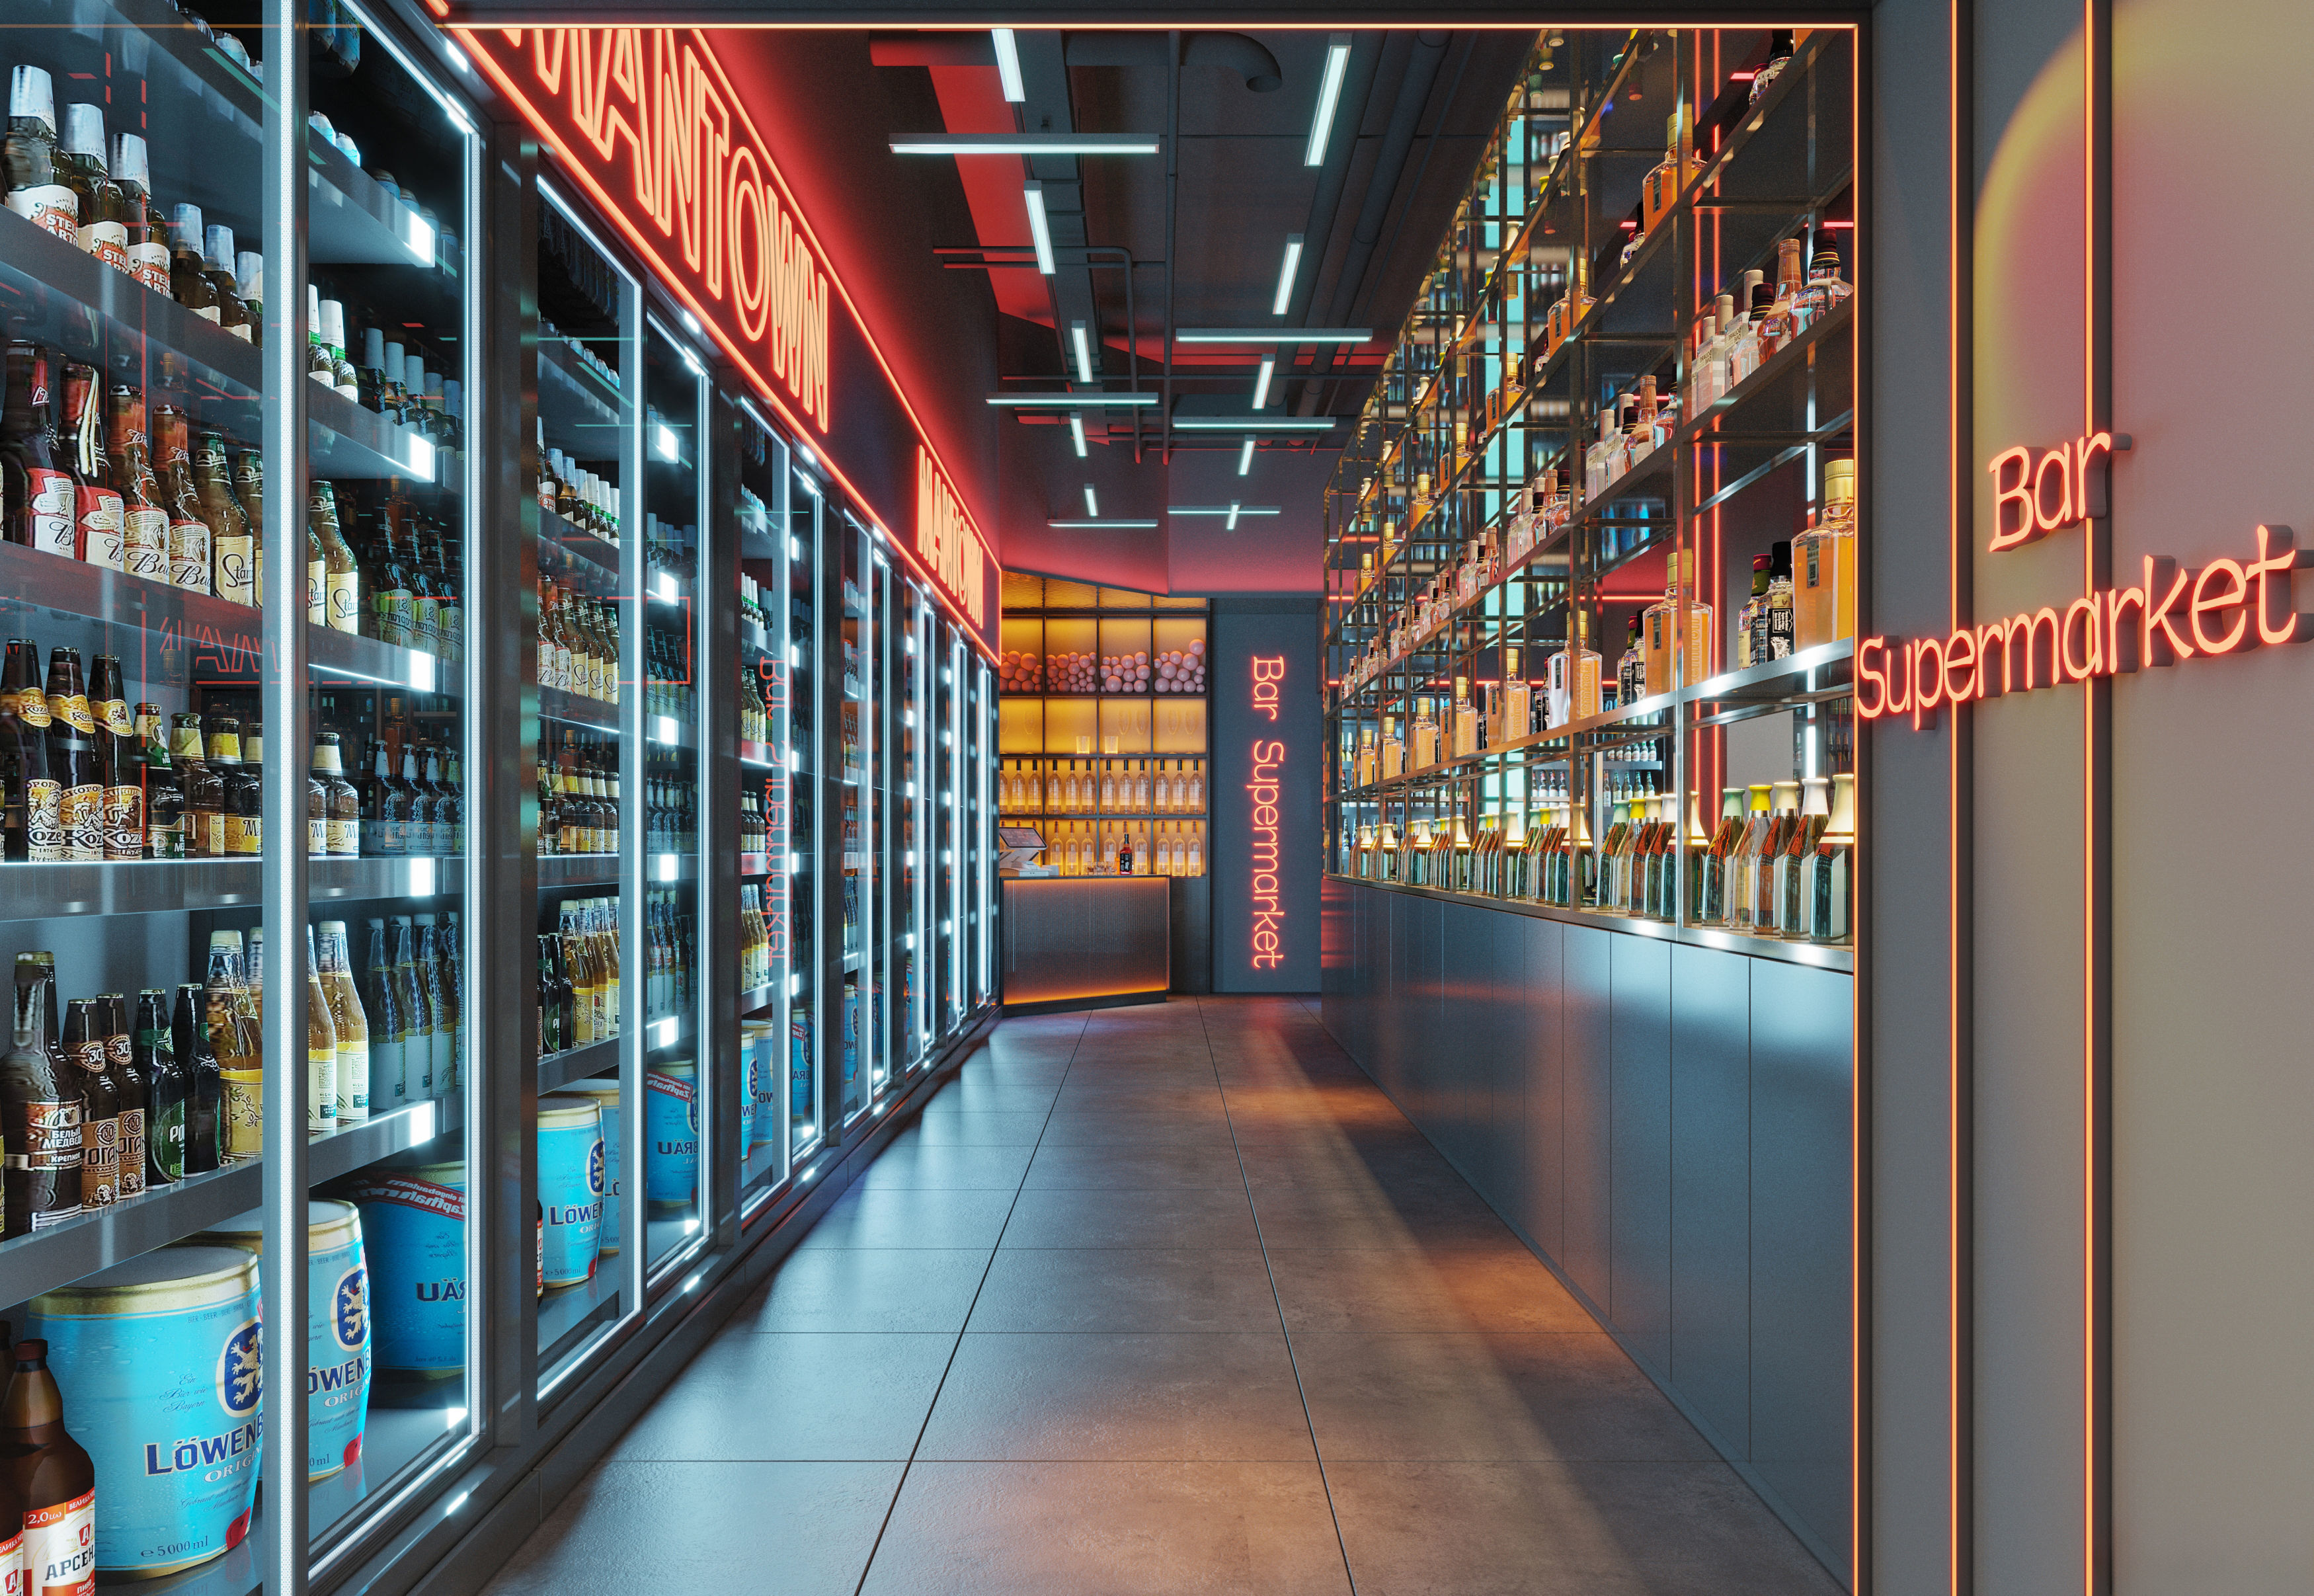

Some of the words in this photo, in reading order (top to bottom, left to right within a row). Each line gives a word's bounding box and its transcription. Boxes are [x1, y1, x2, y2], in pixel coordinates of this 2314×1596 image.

[502, 28, 828, 433] ANTOWN
[917, 444, 984, 629] MANTOWN
[1989, 432, 2111, 552] Bar
[1856, 524, 2297, 731] Supermarket
[1252, 655, 1285, 721] Bar
[1246, 739, 1285, 969] Supermarket
[89, 1049, 102, 1063] 30
[116, 1042, 130, 1056] 30
[317, 1454, 330, 1465] ml
[157, 1540, 190, 1556] 5000
[193, 1535, 208, 1548] ml
